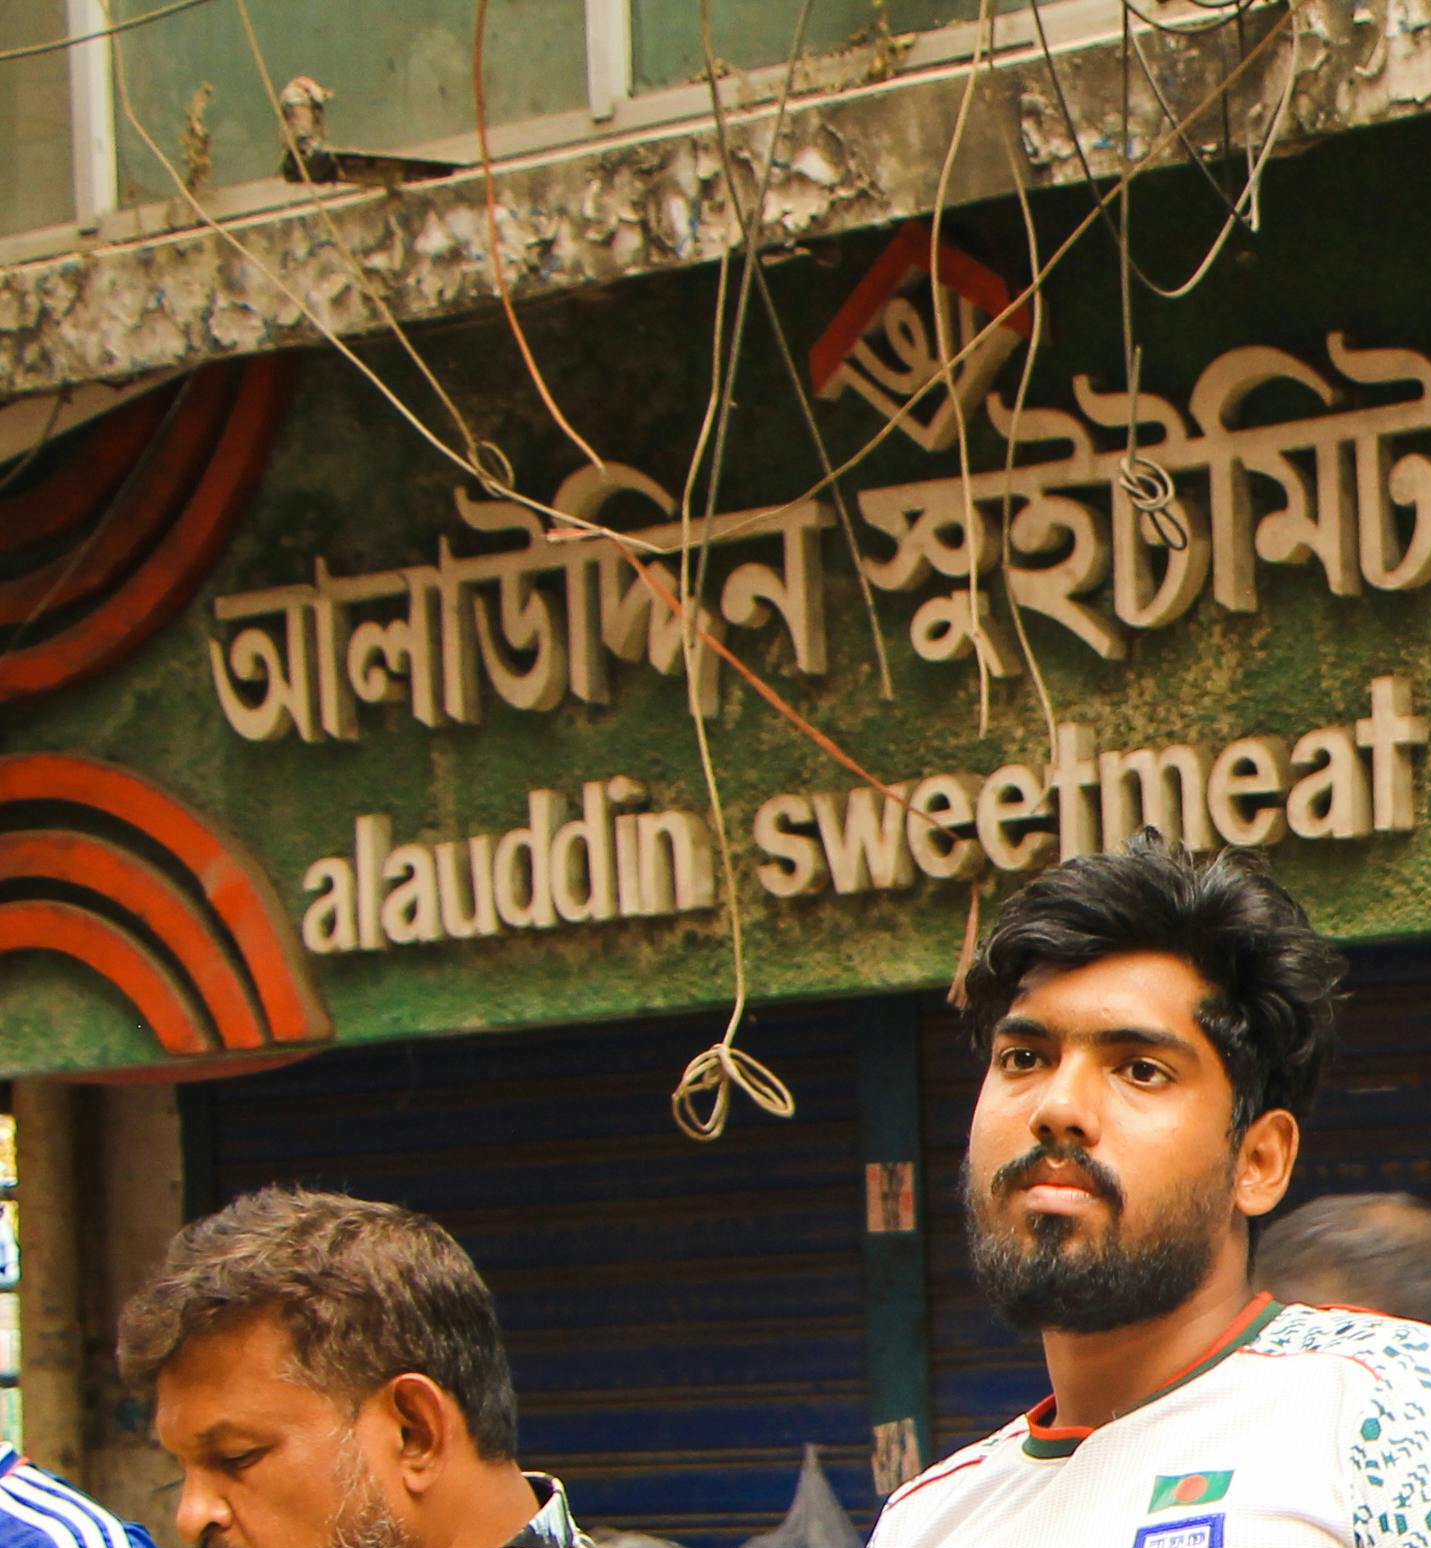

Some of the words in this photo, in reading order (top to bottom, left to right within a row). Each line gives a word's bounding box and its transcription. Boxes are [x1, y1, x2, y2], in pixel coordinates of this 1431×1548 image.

[210, 460, 837, 744] আলাউদ্দিন
[301, 775, 716, 955] alauddin
[755, 675, 1430, 899] sweetmeat
